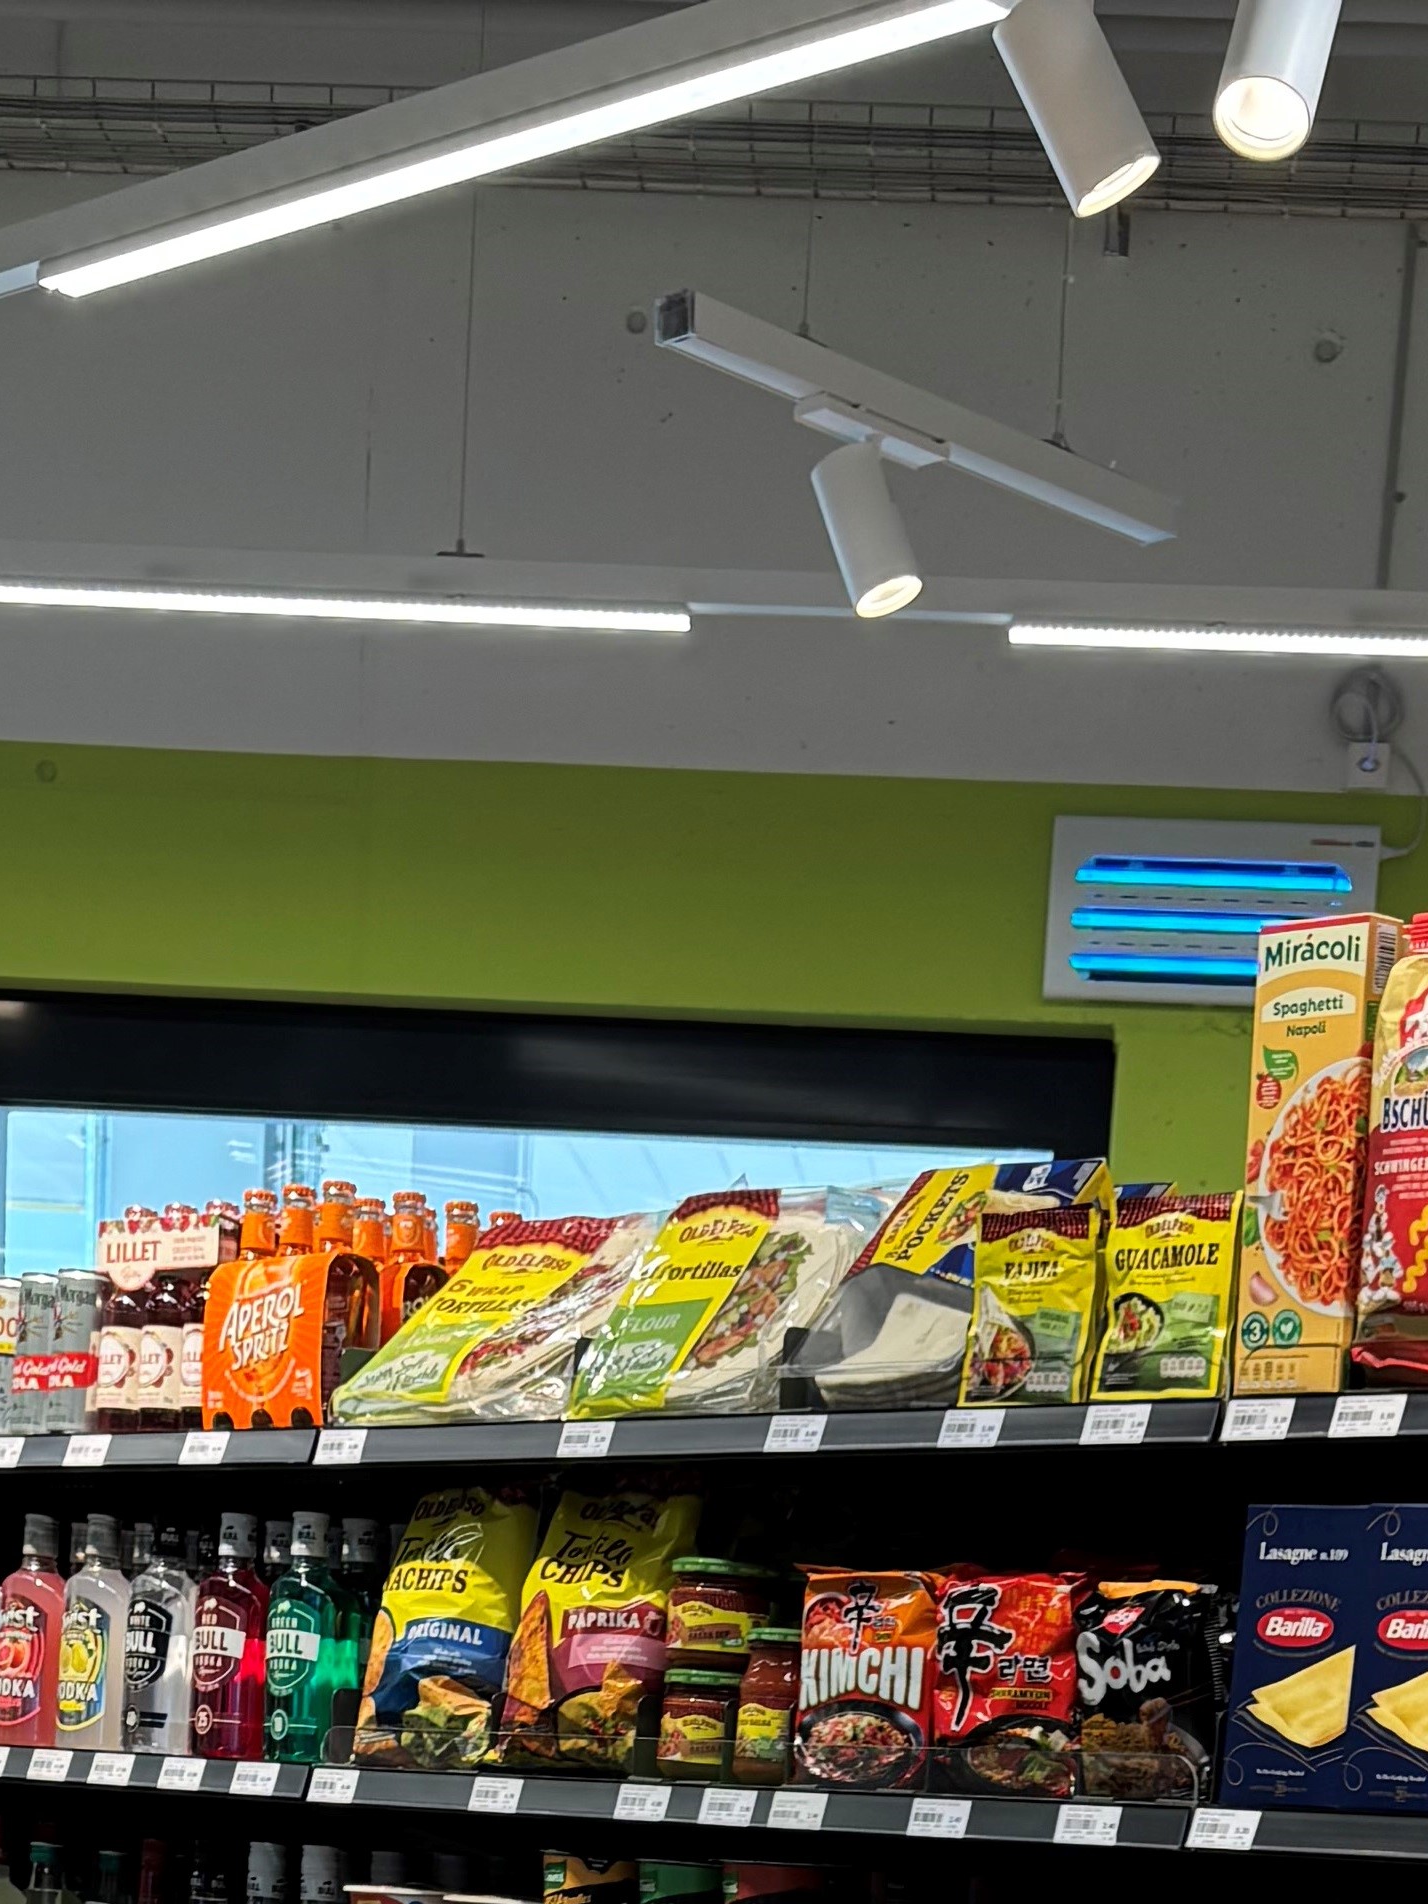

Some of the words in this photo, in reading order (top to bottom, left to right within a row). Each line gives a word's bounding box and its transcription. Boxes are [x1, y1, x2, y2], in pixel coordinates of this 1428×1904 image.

[1265, 935, 1361, 972] Mirácoli
[1272, 993, 1345, 1019] Spaghetti
[106, 1239, 161, 1264] LILLET
[1114, 1243, 1219, 1272] GUACAMOLE
[219, 1286, 306, 1353] APEROL
[1259, 1541, 1319, 1566] Lasagne
[567, 1610, 642, 1631] PAPRIKA
[1265, 1616, 1329, 1639] Barilla
[799, 1646, 925, 1710] KIMCHI
[1075, 1631, 1172, 1707] Soba
